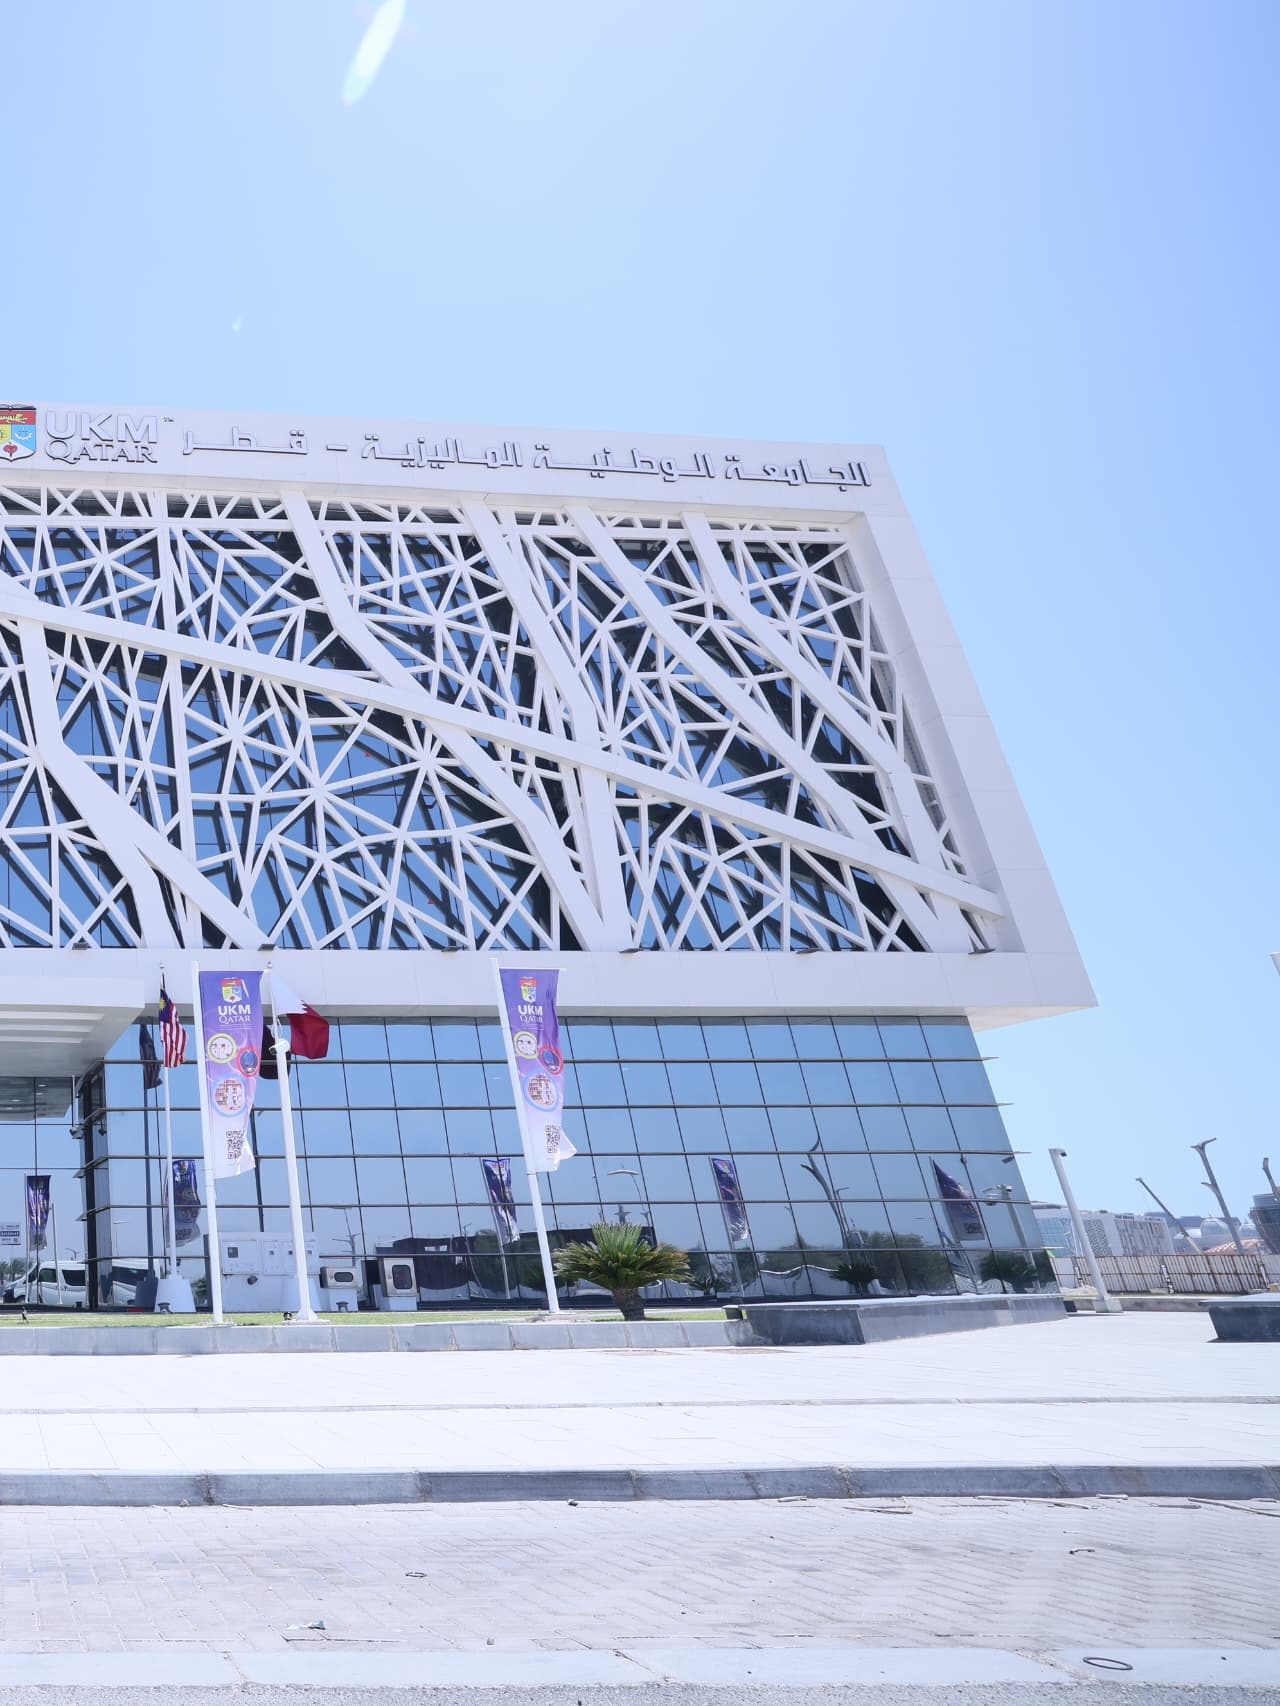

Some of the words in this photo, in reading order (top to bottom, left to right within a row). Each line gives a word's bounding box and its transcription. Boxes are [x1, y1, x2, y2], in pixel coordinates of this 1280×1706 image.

[45, 410, 158, 444] UKM
[182, 426, 308, 455] قطر
[45, 439, 158, 465] QATAR
[326, 443, 349, 452] -
[361, 432, 524, 469] الماليزية
[533, 444, 716, 483] الوطنية
[724, 454, 872, 492] الجامعة
[217, 1004, 251, 1016] UKM
[218, 1015, 251, 1025] QATAR
[517, 1004, 543, 1016] UKM
